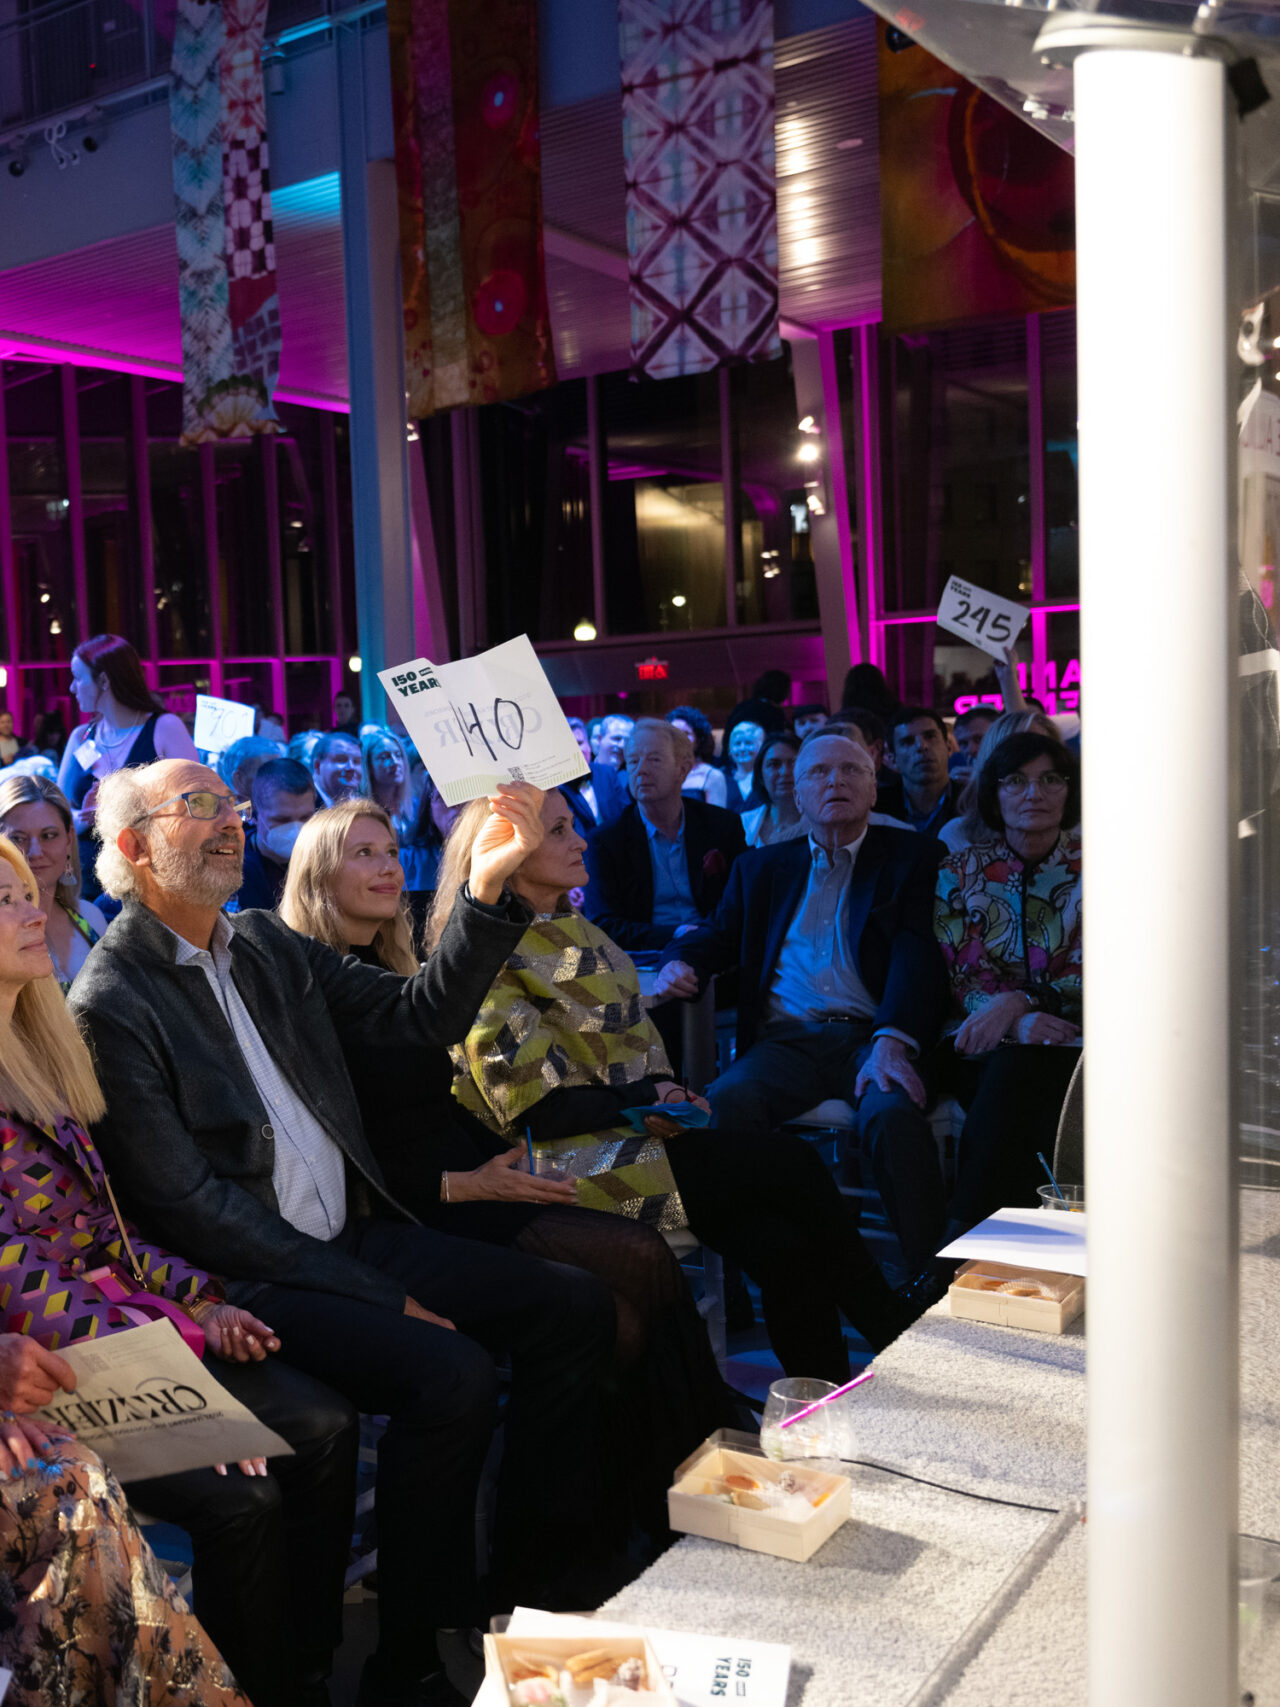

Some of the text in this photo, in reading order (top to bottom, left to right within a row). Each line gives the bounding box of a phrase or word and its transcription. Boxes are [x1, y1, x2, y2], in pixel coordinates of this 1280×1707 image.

[951, 600, 1011, 643] 245
[391, 671, 417, 687] 150
[398, 677, 442, 697] YEAR
[710, 1656, 732, 1696] YEARS
[735, 1657, 752, 1678] 150
